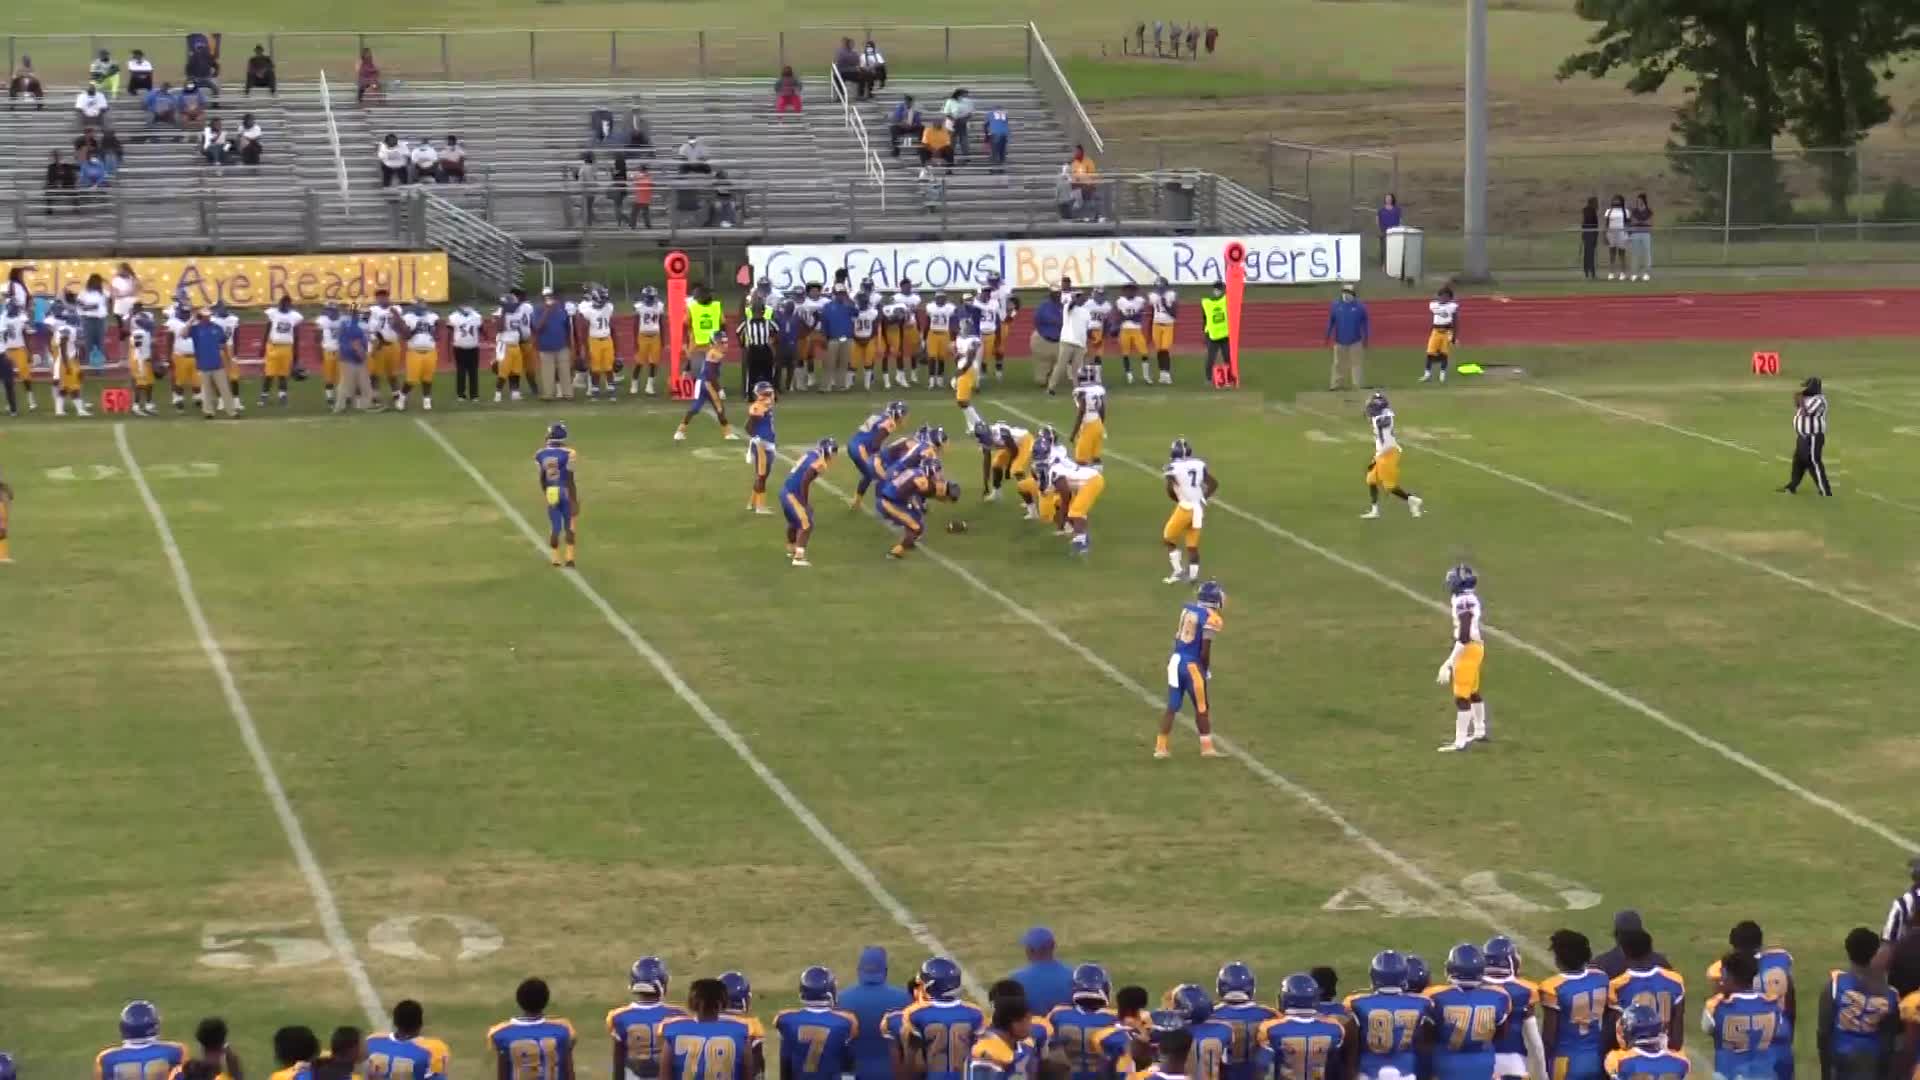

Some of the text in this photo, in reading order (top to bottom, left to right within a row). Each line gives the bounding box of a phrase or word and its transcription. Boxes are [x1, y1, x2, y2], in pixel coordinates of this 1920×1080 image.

[1756, 354, 1777, 376] 20
[103, 390, 125, 412] 50
[1186, 470, 1198, 488] 7
[1367, 1009, 1420, 1054] 87
[1722, 1012, 1776, 1053] 57
[797, 1024, 831, 1073] 7
